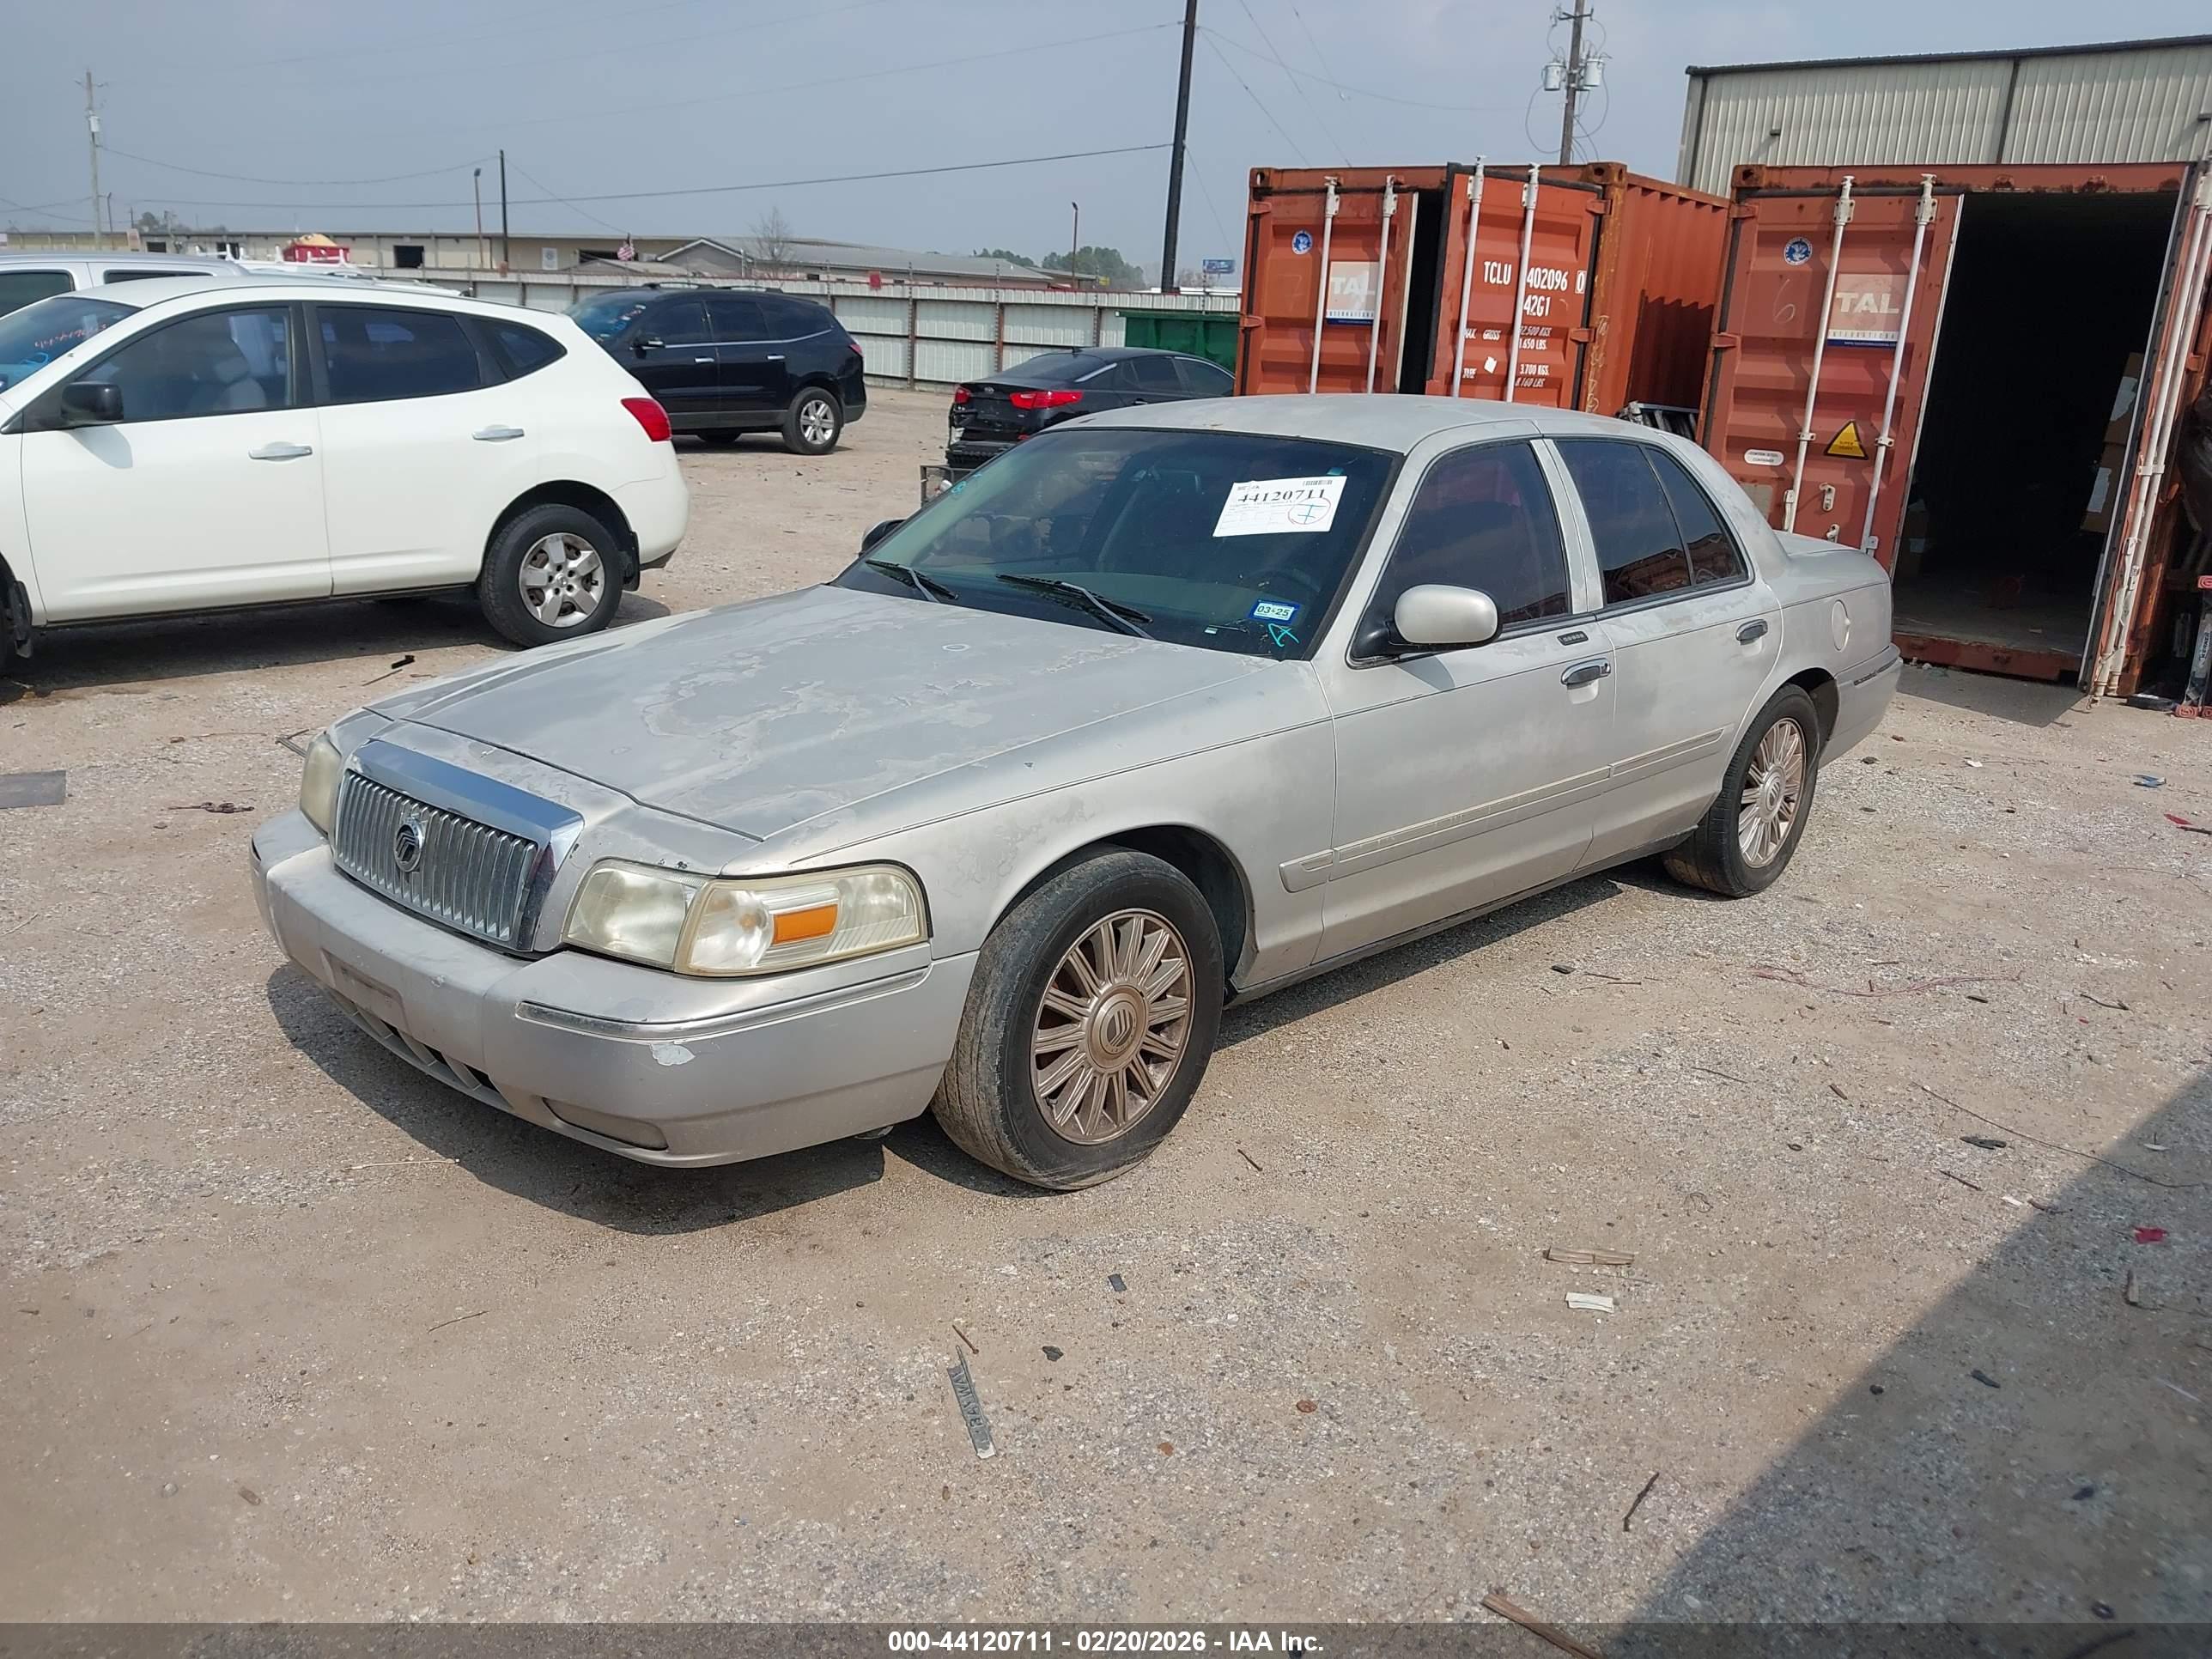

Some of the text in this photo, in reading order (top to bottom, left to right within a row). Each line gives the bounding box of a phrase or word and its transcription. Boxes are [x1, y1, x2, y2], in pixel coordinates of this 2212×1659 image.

[1484, 261, 1587, 294] TCLU 402096 0
[1523, 295, 1552, 317] 42G1
[1835, 293, 1899, 314] TAL
[1237, 489, 1325, 502] 44120711
